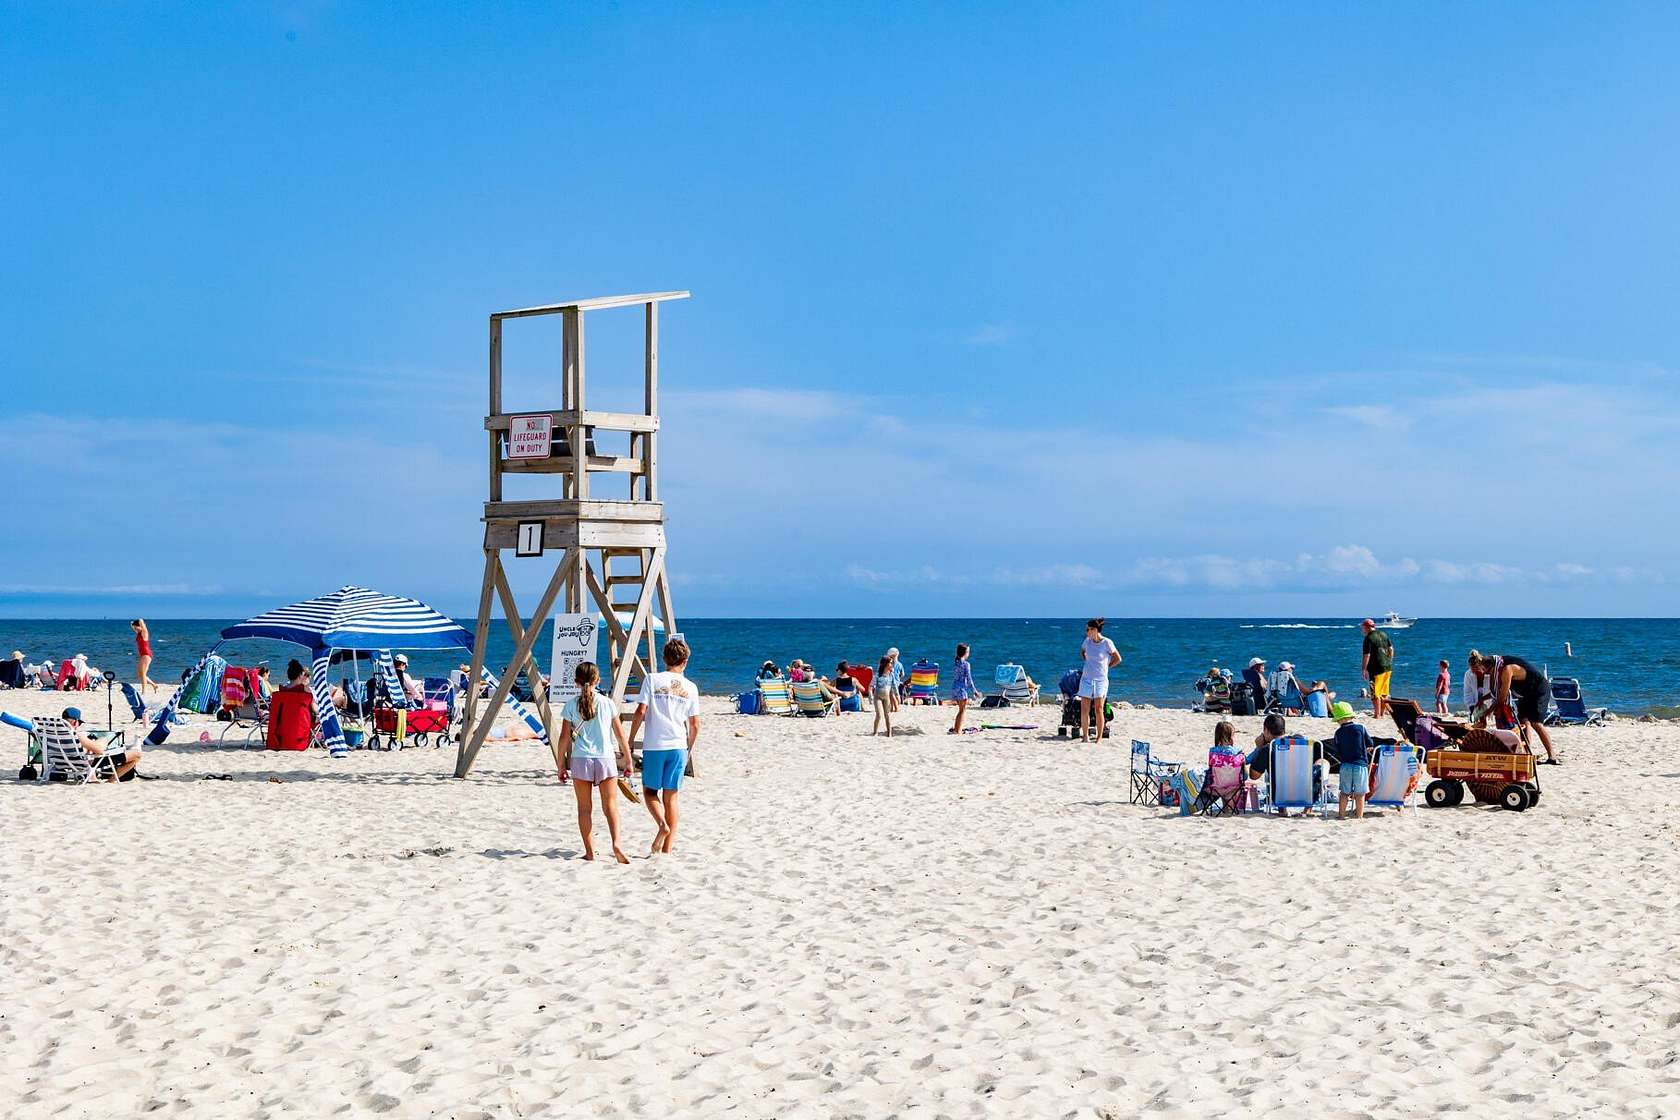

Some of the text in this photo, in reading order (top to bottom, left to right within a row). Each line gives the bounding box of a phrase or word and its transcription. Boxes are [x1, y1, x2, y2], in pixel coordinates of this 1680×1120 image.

[527, 420, 536, 430] NO
[514, 432, 546, 441] LIFEGUARD
[516, 444, 543, 453] ON DUTY
[528, 526, 532, 551] 1
